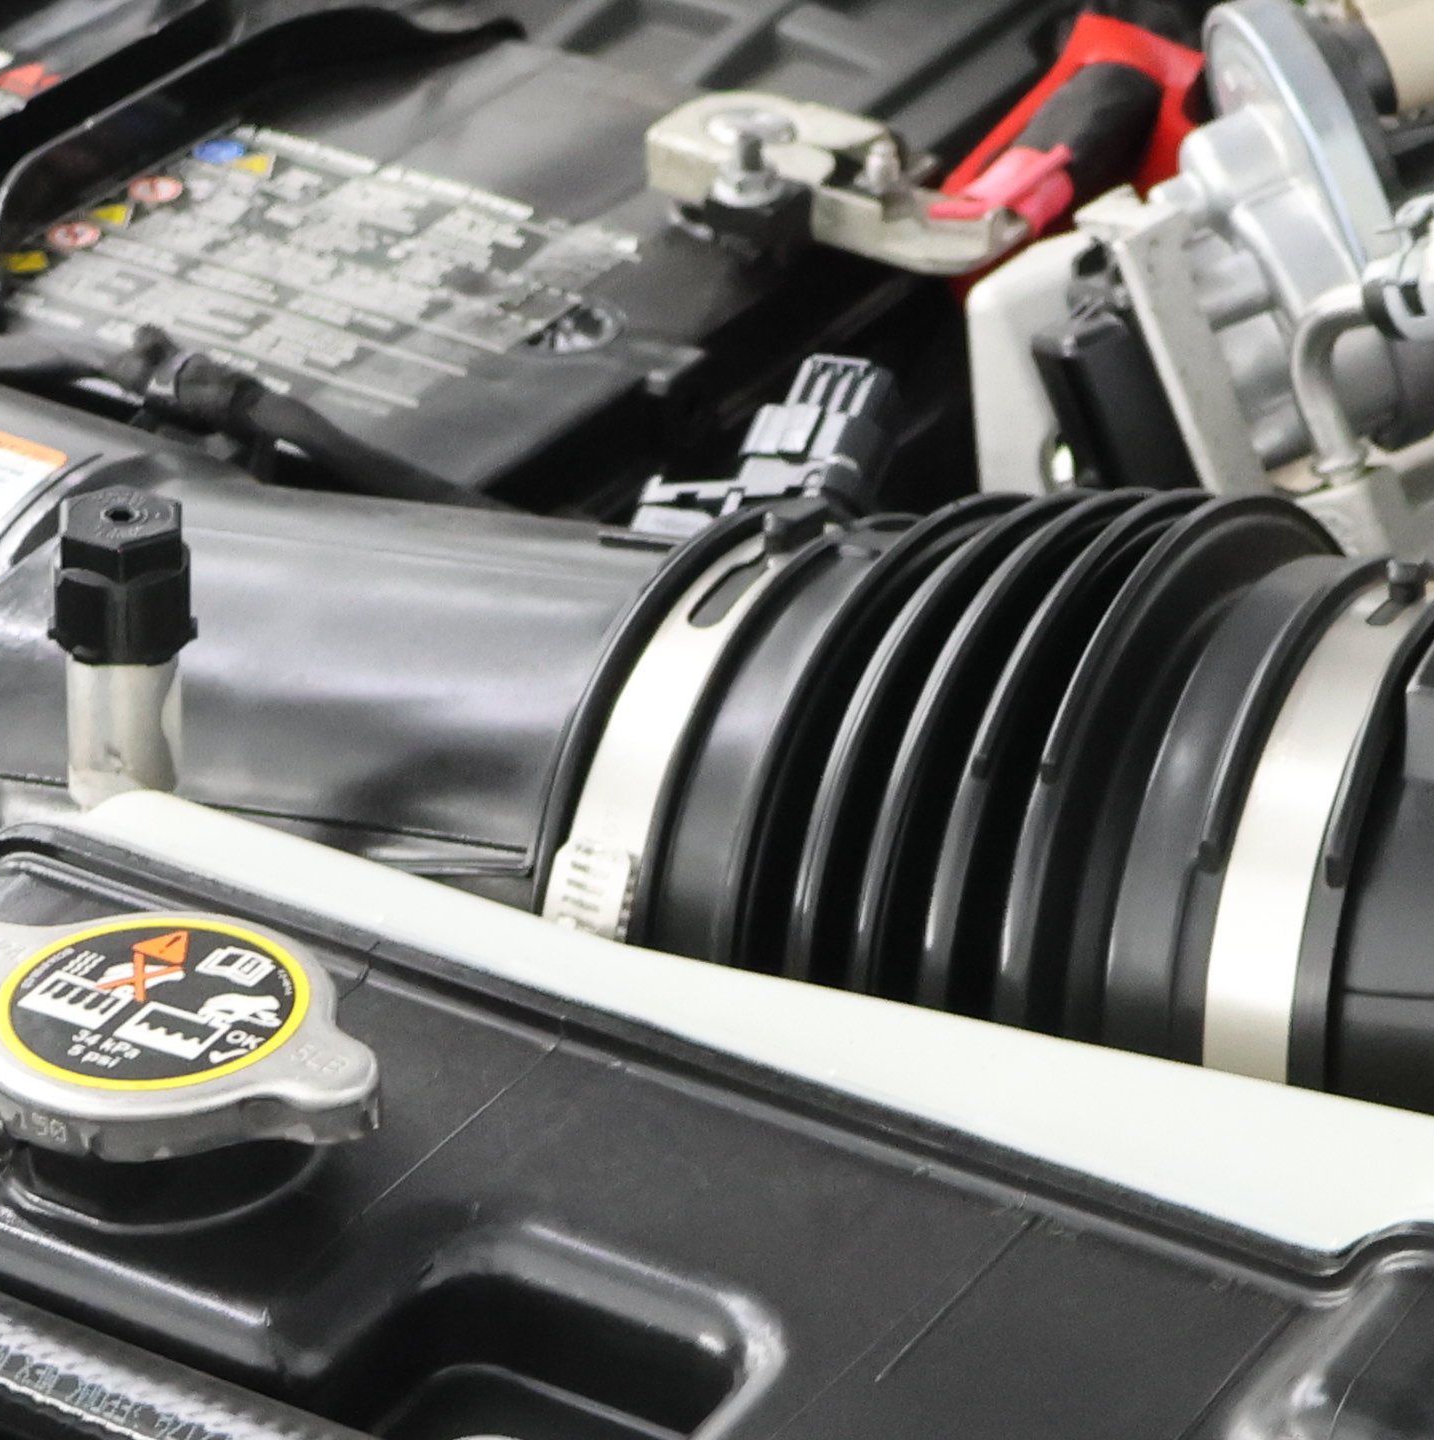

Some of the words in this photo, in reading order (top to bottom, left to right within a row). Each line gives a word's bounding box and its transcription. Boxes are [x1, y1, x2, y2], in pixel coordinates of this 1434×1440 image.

[71, 1028, 99, 1049] 34
[102, 1036, 142, 1060] kPa
[225, 1030, 265, 1049] OK
[81, 1048, 121, 1069] psi
